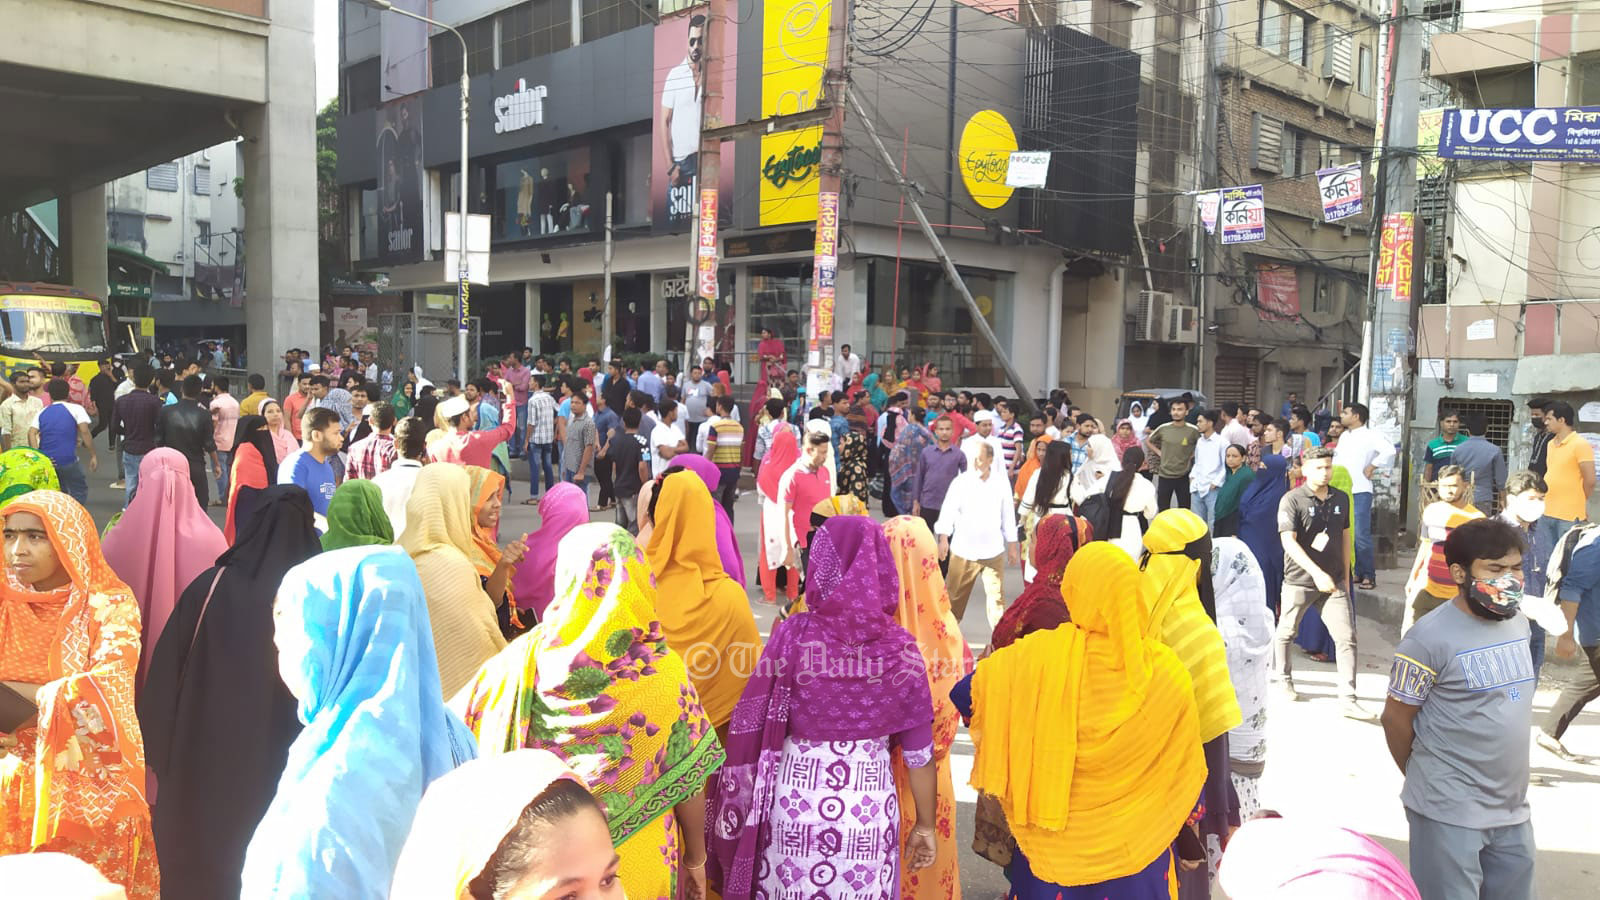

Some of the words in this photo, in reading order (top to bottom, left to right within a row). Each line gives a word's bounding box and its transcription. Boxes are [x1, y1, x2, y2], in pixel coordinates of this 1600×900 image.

[495, 78, 547, 134] sailor
[1459, 109, 1557, 145] UCC
[670, 175, 697, 215] sail
